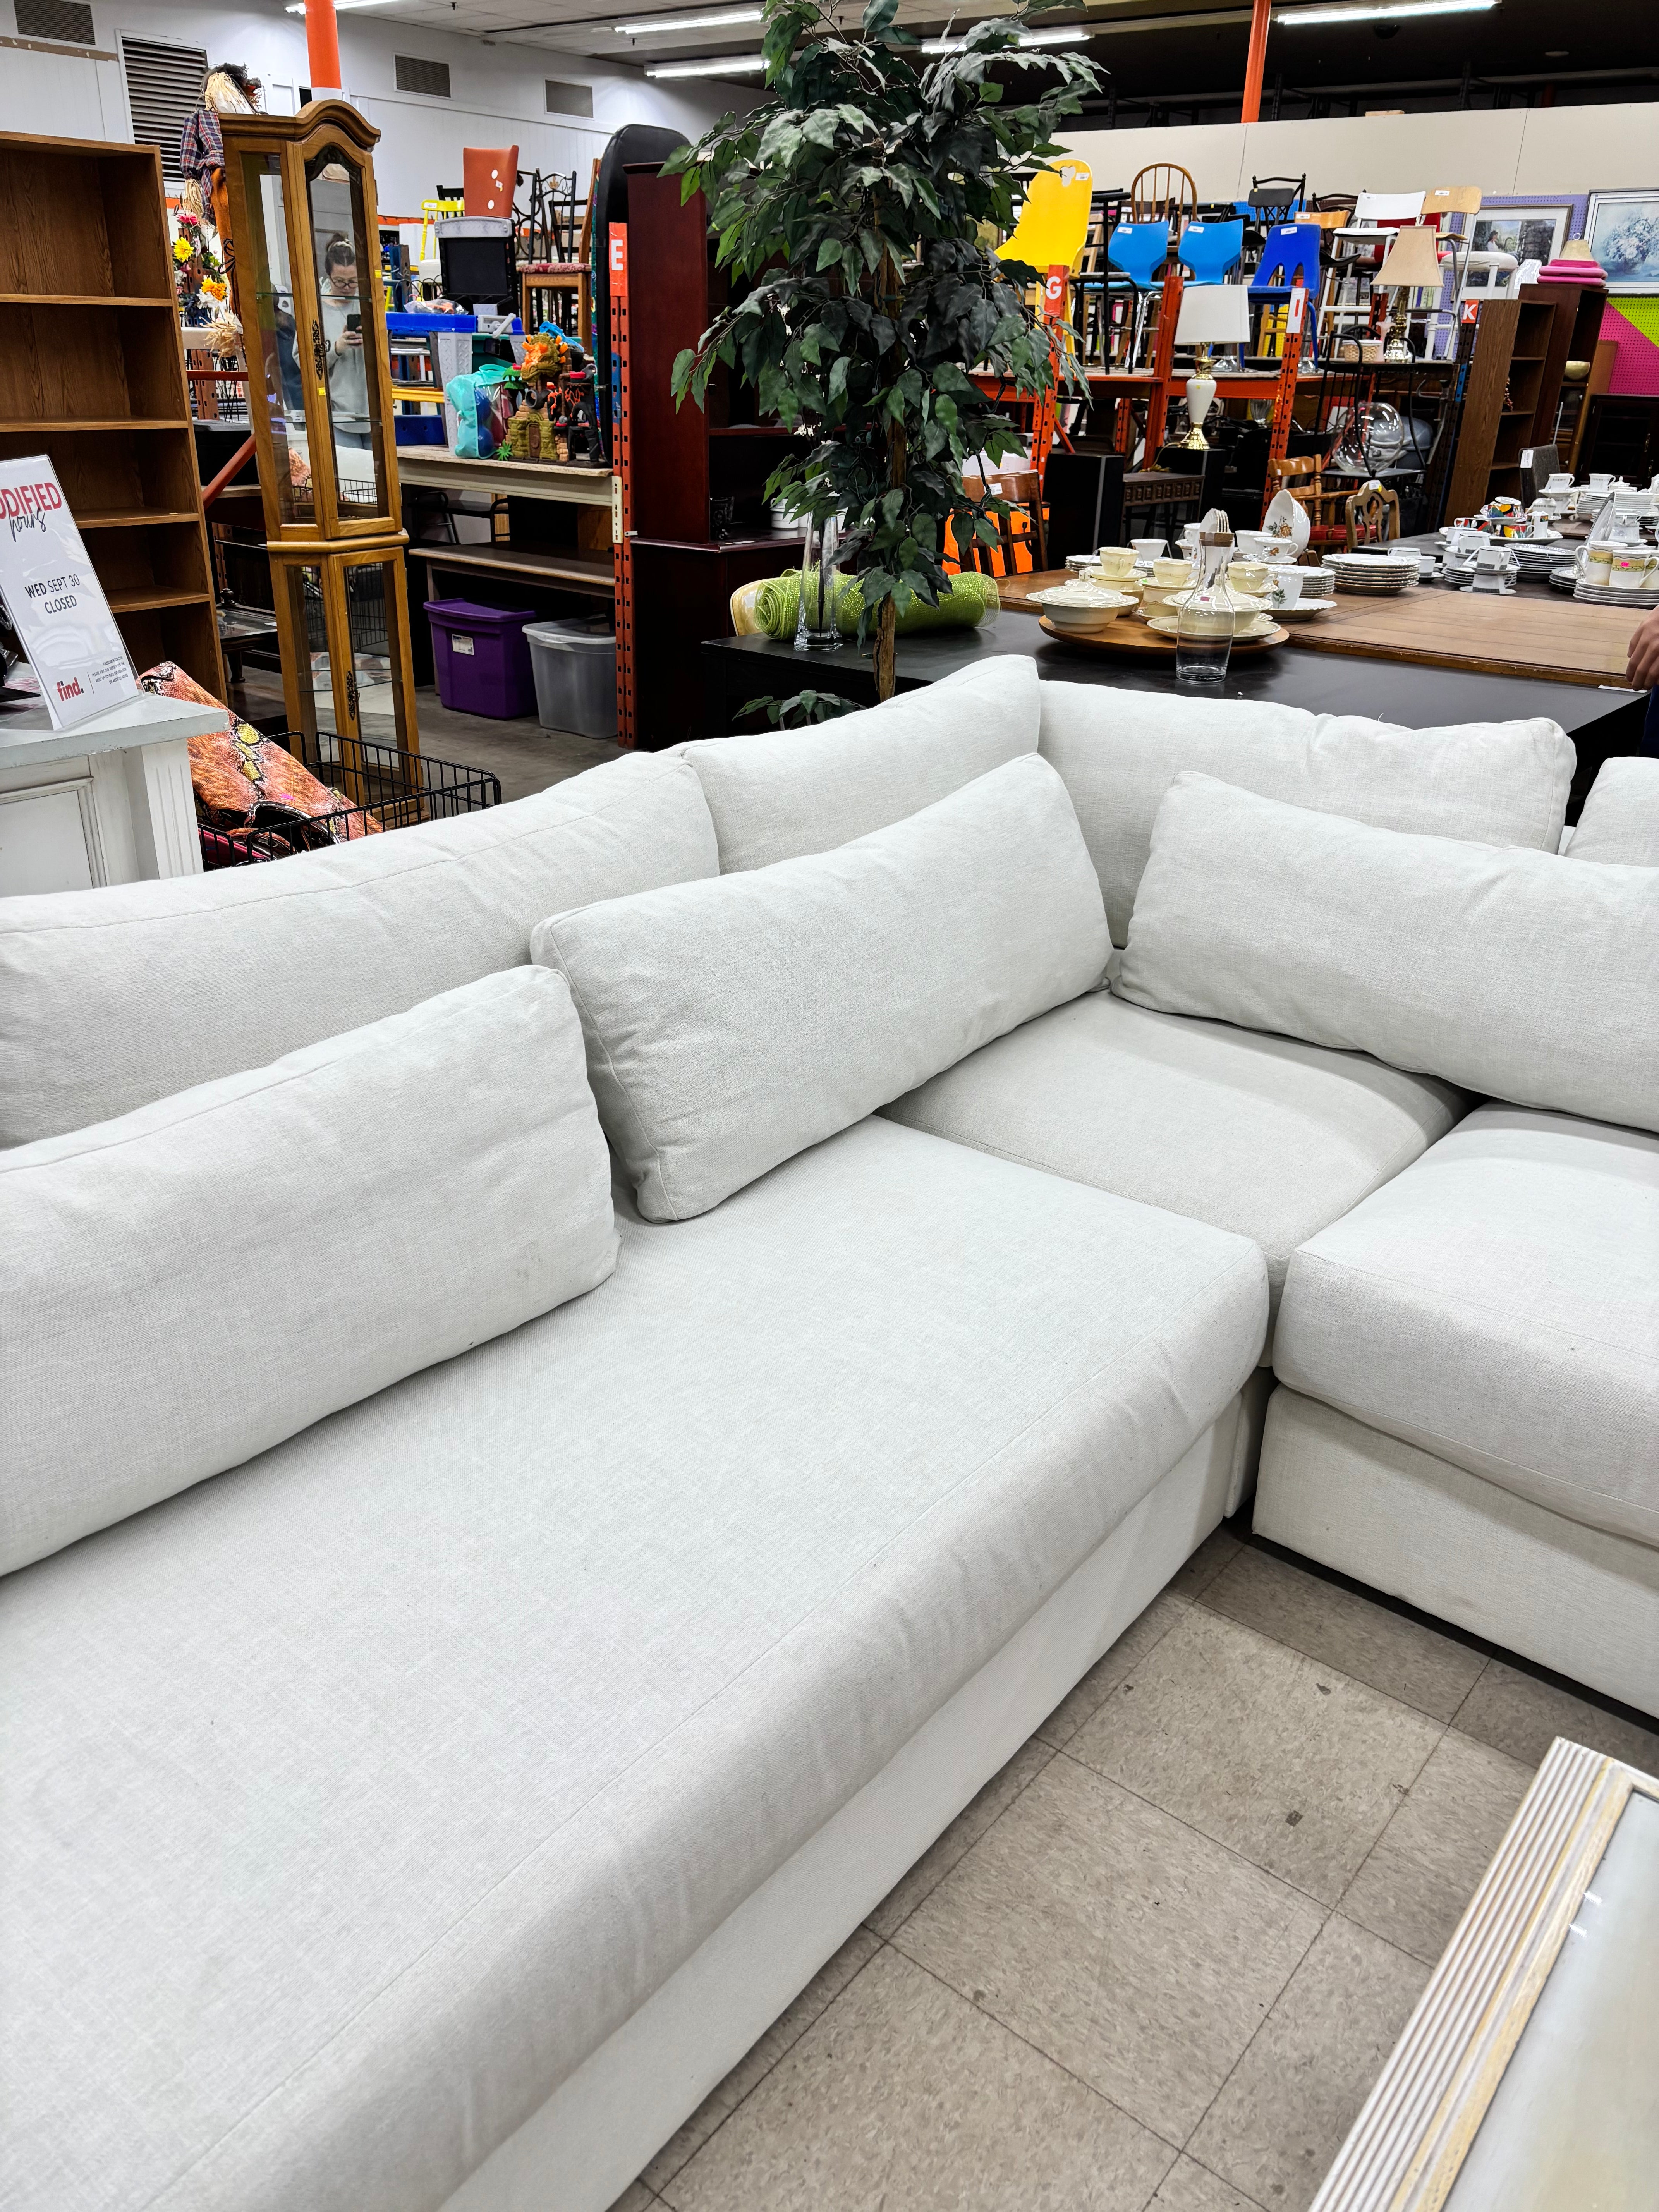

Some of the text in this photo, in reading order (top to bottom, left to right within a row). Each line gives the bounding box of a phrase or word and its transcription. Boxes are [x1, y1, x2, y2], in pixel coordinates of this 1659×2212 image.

[611, 239, 623, 270] E
[1046, 276, 1062, 300] G
[1463, 304, 1477, 320] K
[7, 499, 46, 542] hours
[24, 574, 80, 599] WED SEPT 30
[44, 595, 77, 614] CLOSED
[57, 677, 84, 701] find.
